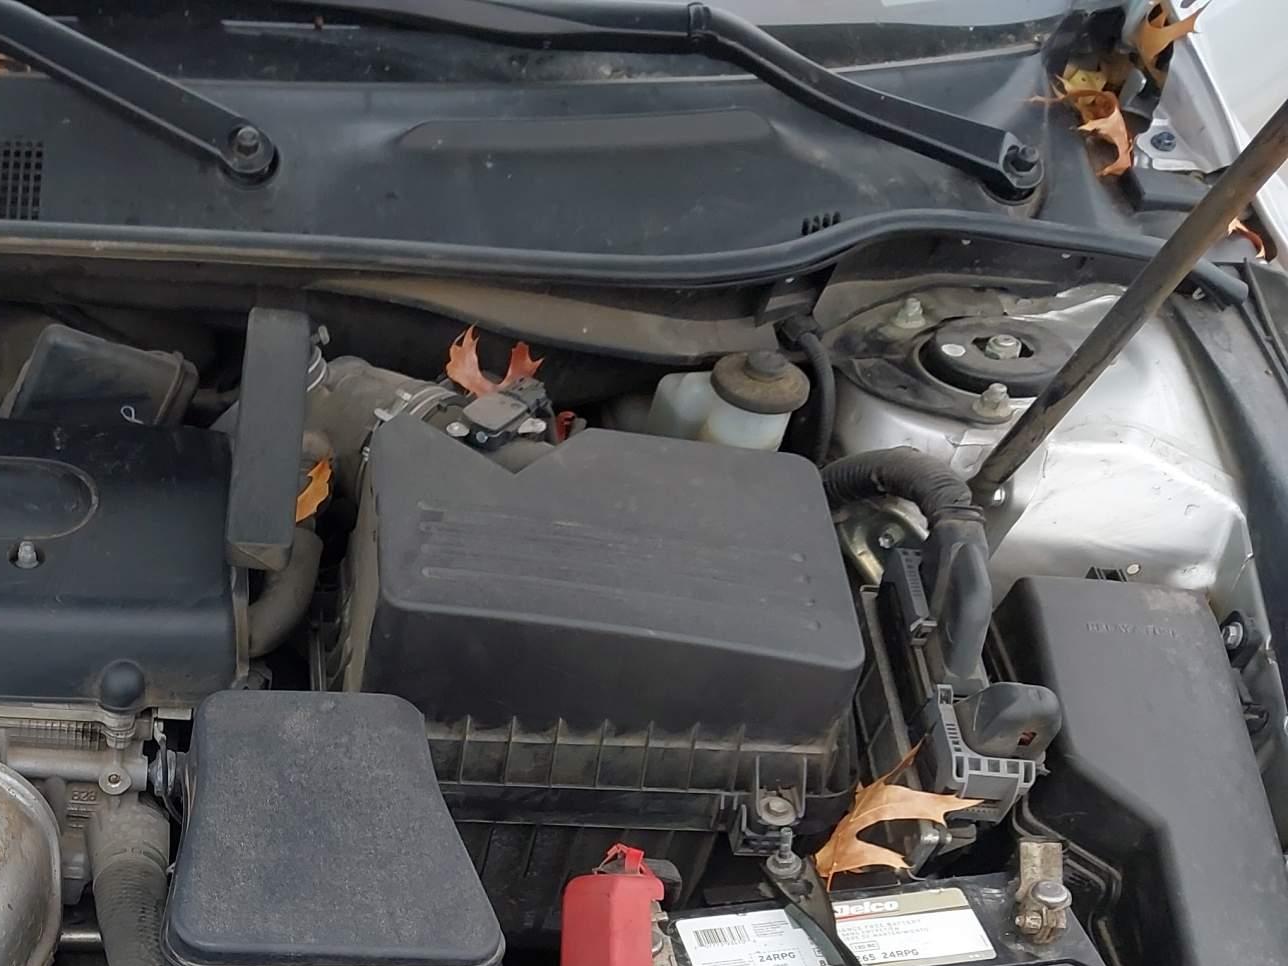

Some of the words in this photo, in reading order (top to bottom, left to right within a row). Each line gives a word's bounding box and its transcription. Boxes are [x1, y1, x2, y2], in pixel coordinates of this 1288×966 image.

[833, 901, 899, 917] Delco
[758, 950, 797, 963] 24RPG
[881, 948, 920, 960] 24RPG
